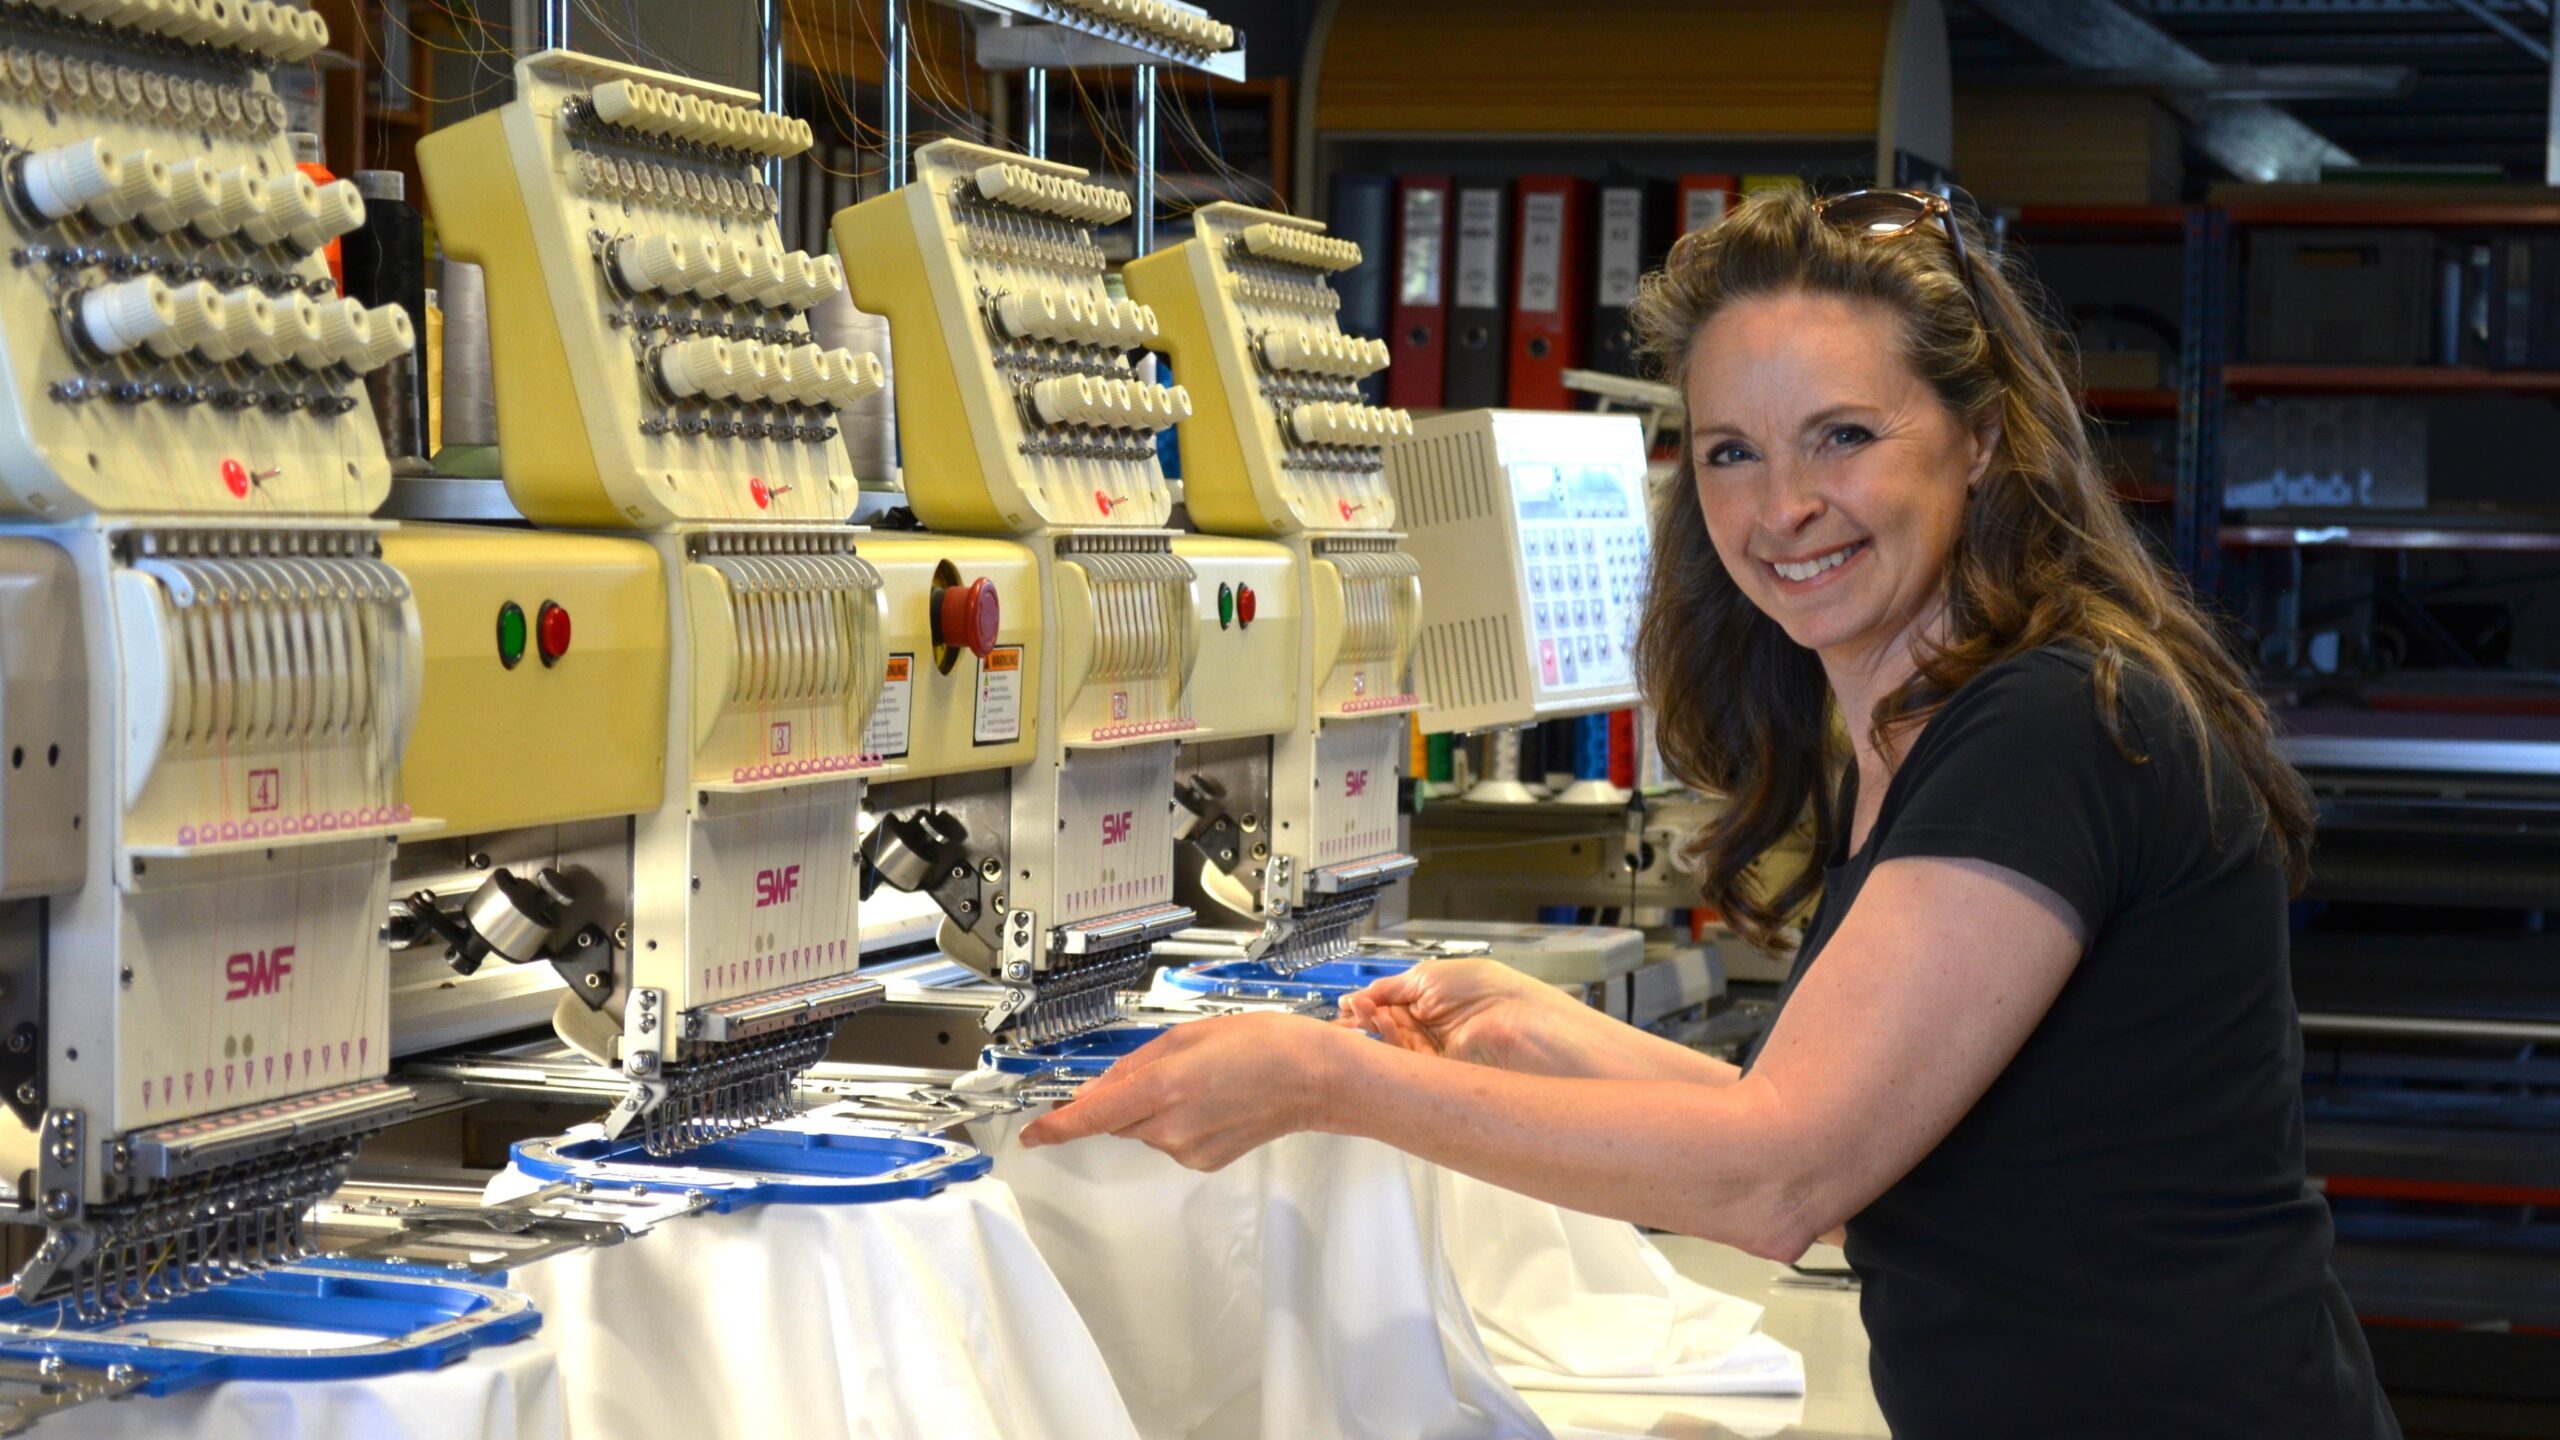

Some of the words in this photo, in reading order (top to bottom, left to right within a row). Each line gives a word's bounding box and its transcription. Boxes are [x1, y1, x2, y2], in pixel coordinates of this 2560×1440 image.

[1345, 770, 1368, 797] SWF
[1102, 811, 1133, 846] SWF
[756, 865, 800, 908] SWF
[225, 945, 295, 1001] SWF
